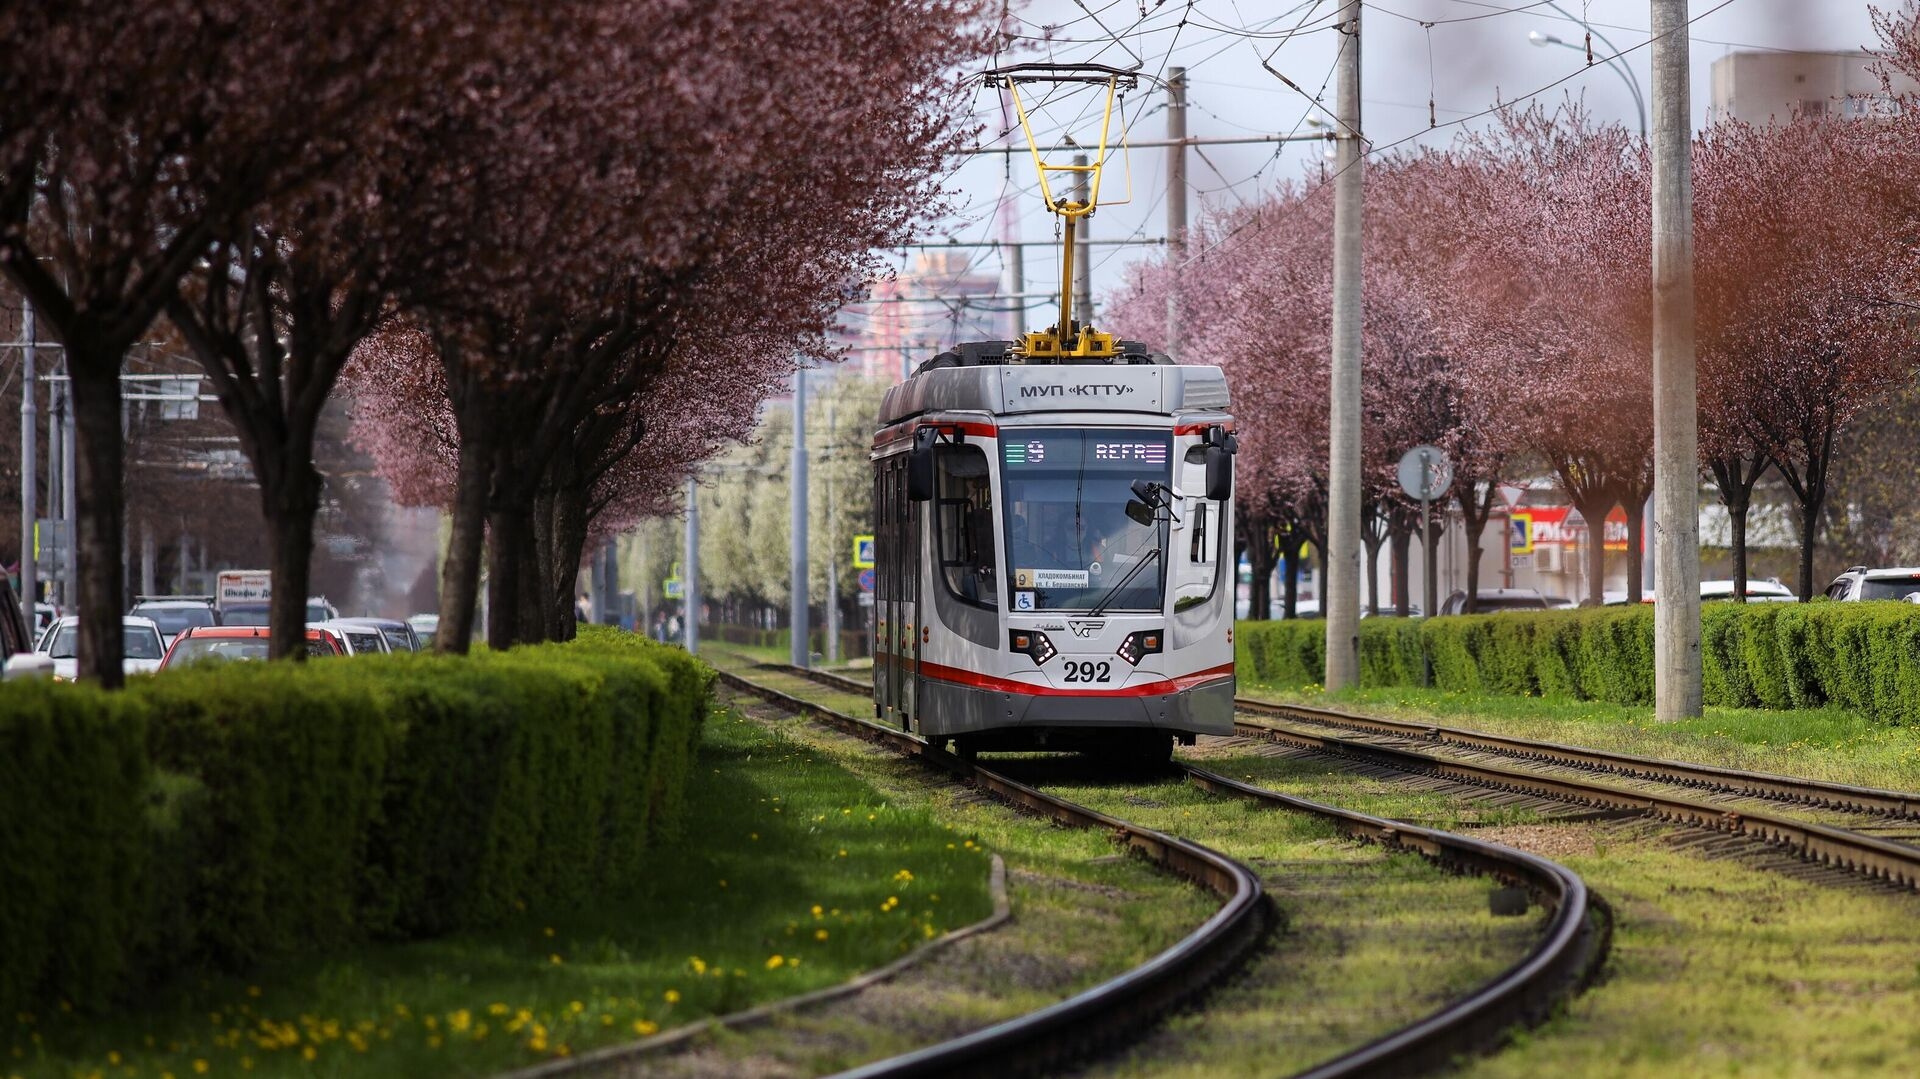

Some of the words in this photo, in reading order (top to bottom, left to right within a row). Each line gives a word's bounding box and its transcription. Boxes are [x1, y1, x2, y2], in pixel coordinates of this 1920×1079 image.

[1020, 385, 1064, 397] МУП
[1068, 384, 1134, 396] «КТТУ»
[1018, 574, 1026, 586] 9
[1064, 662, 1111, 682] 292
